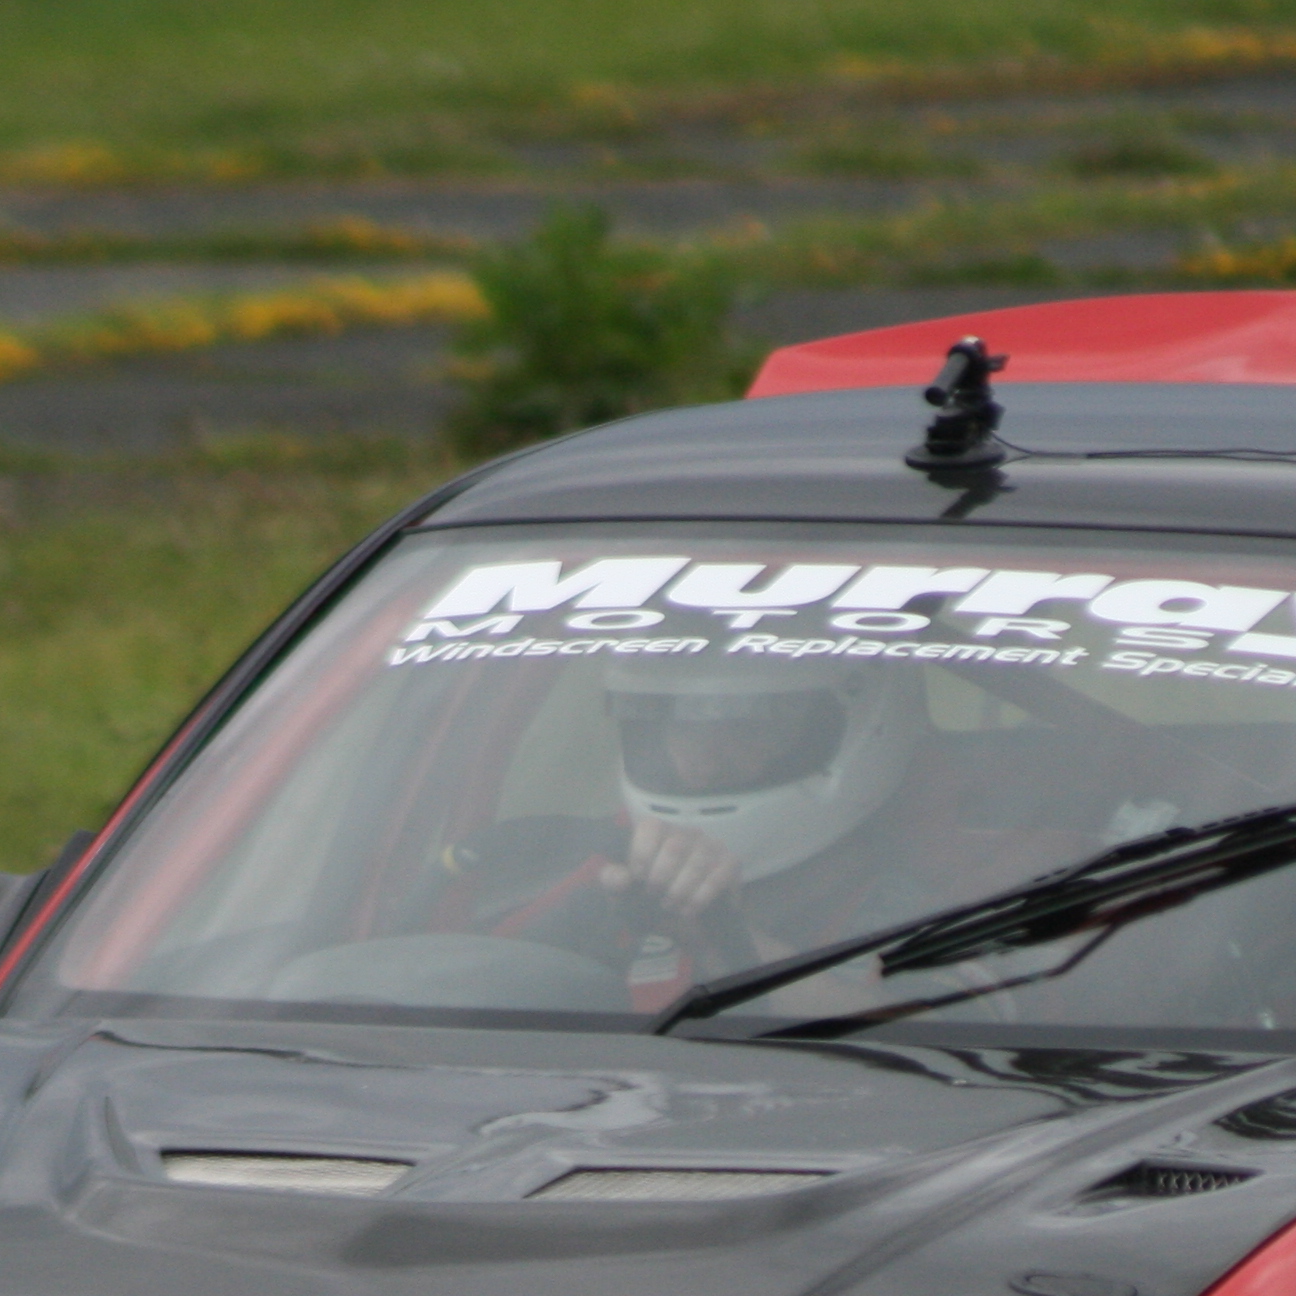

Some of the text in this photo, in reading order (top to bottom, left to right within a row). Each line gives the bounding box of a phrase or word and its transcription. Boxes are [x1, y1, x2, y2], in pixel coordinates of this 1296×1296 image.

[404, 609, 1216, 651] MOTORS
[390, 634, 710, 666] Windscreen
[728, 632, 1091, 667] Replacement
